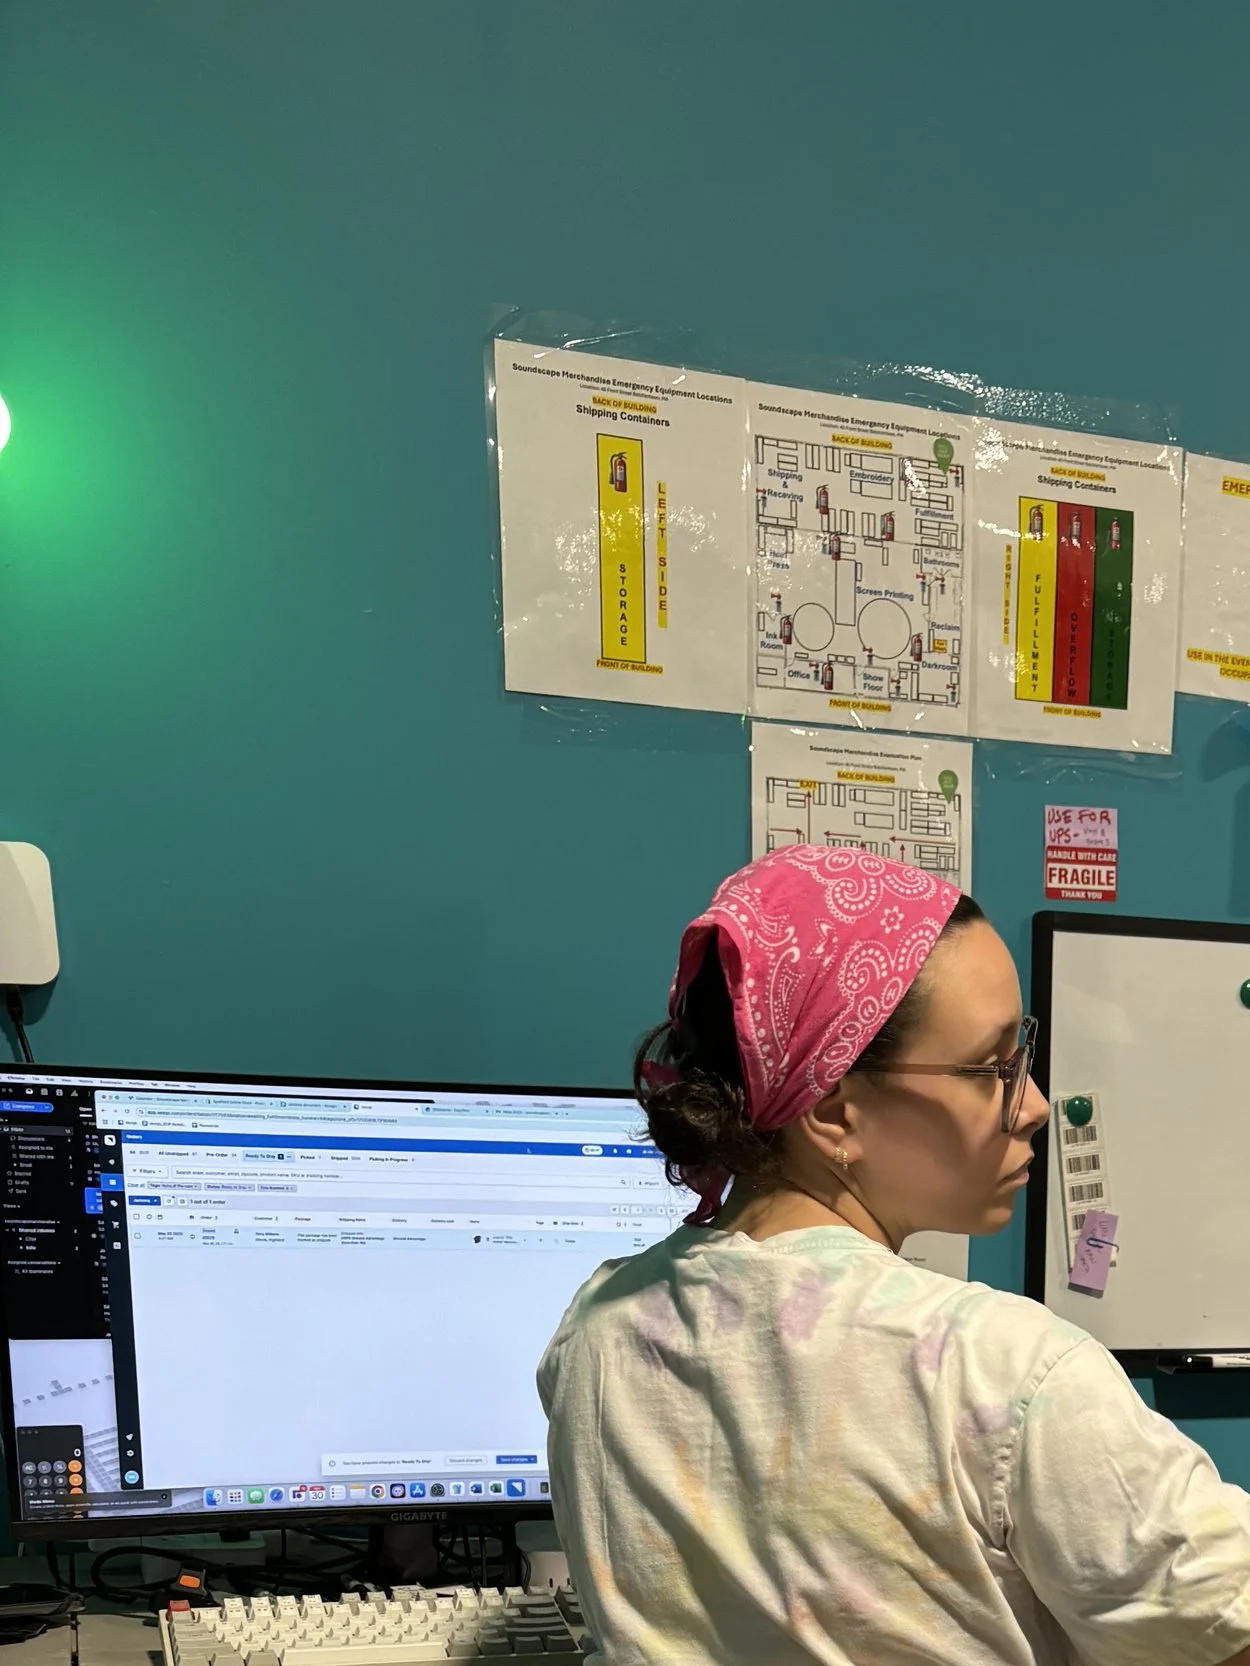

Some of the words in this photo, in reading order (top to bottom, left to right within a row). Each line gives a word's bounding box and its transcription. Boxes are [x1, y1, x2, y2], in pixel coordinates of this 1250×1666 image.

[512, 362, 561, 378] Soundscape
[561, 370, 611, 386] Merchandise
[612, 379, 654, 394] Emergency
[655, 385, 695, 399] Equipment
[696, 392, 733, 405] Locations
[592, 396, 611, 408] BACK
[612, 400, 623, 409] OF
[624, 401, 657, 414] BUILDING
[576, 404, 618, 421] Shipping
[619, 411, 670, 428] Containers
[758, 402, 803, 417] Soundscape
[803, 410, 850, 424] Merchandise
[850, 417, 890, 431] Emergency
[890, 423, 927, 436] Equipment
[928, 428, 961, 441] Locations
[831, 434, 850, 445] BACK
[850, 437, 860, 446] OF
[861, 438, 893, 450] BUILDING
[1068, 450, 1104, 463] Emergency
[1104, 455, 1139, 468] Equipment
[767, 468, 803, 483] Shipping
[849, 469, 895, 484] Embroidery
[1051, 467, 1067, 476] BACK
[1068, 469, 1077, 477] OF
[1077, 471, 1106, 482] BUILDING
[782, 480, 789, 489] &
[1037, 474, 1074, 490] Shipping
[1074, 480, 1117, 494] Containers
[658, 483, 666, 538] LEFT
[914, 507, 954, 521] Fulfillment
[923, 556, 961, 569] Bathrooms
[658, 556, 667, 611] SIDE
[856, 585, 883, 598] Screen
[884, 589, 914, 602] Printing
[619, 563, 628, 646] STORAGE
[930, 621, 961, 632] Reclaim
[1032, 574, 1042, 693] FULFILLMENT
[765, 631, 778, 640] Ink
[760, 640, 784, 651] Room
[1067, 612, 1078, 697] OVERFLOW
[1187, 649, 1203, 661] USE
[1203, 652, 1213, 662] IN
[1213, 653, 1230, 665] THE
[596, 659, 619, 670] FRONT
[620, 662, 630, 671] OF
[630, 663, 663, 675] BUILDING
[921, 660, 958, 672] Darkroom
[787, 669, 811, 680] Office
[862, 672, 884, 683] Show
[862, 682, 884, 692] Floor
[829, 699, 850, 709] FRONT
[850, 701, 861, 710] OF
[861, 702, 892, 713] BUILDING
[1043, 705, 1064, 714] FRONT
[1064, 708, 1072, 716] OF
[1073, 709, 1102, 719] BUILDING
[800, 779, 817, 789] EXIT
[837, 771, 855, 780] BACK
[855, 772, 865, 781] OF
[865, 773, 896, 784] BUILDING
[1047, 808, 1073, 825] USE
[1077, 809, 1112, 826] FOR
[1047, 849, 1077, 861] HANDLE
[1076, 851, 1097, 862] WITH
[1097, 852, 1117, 862] CARE
[1048, 866, 1115, 887] FRAGILE
[1060, 889, 1086, 899] THANK
[1087, 891, 1103, 900] YOU
[74, 1448, 82, 1457] 0
[311, 1491, 324, 1500] 30
[390, 1511, 449, 1522] GIGABYTE
